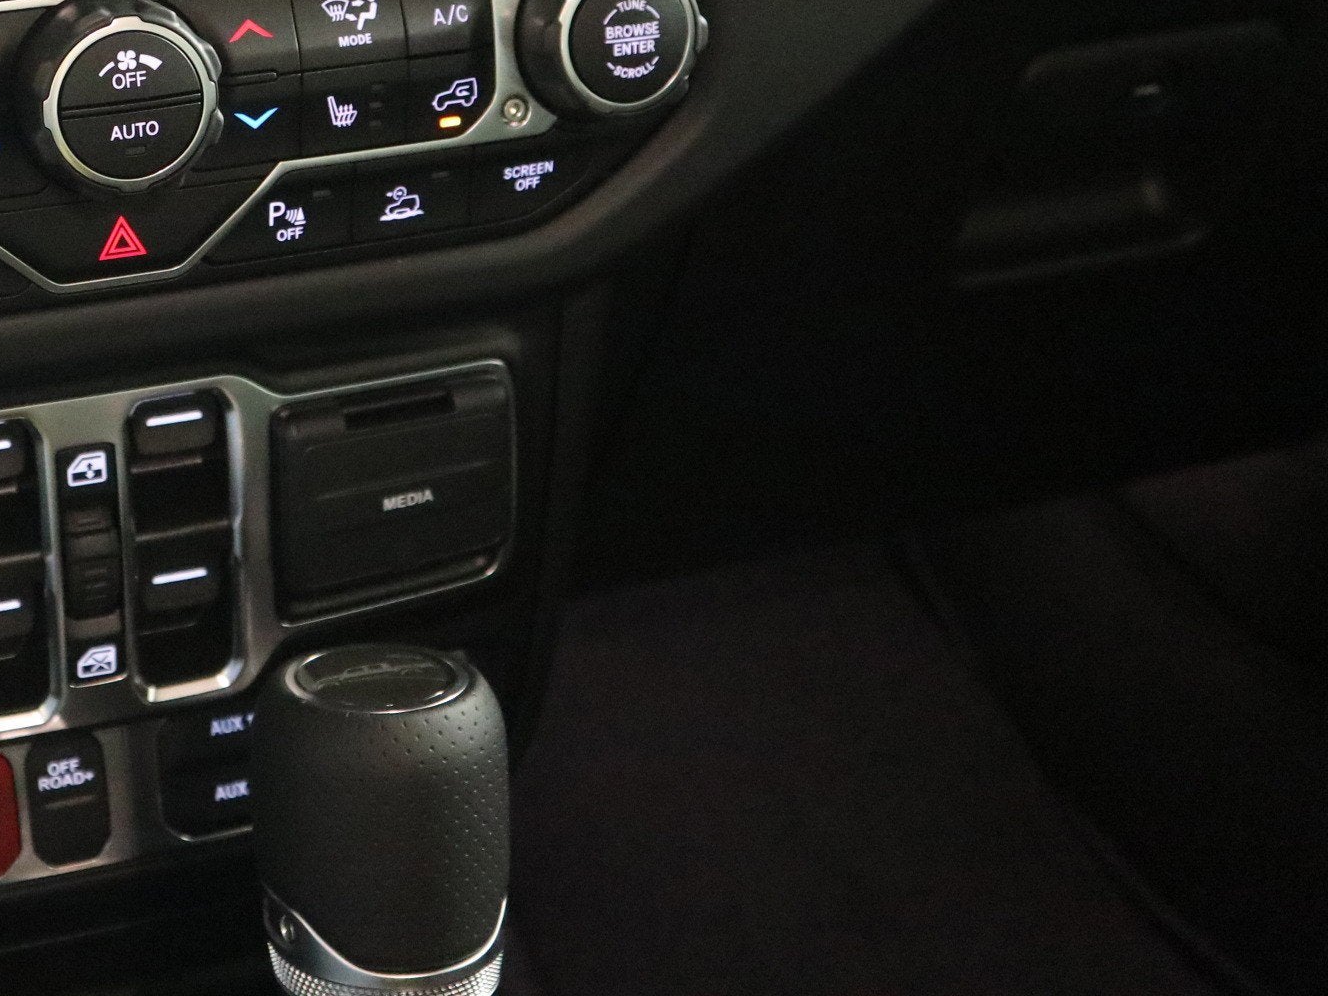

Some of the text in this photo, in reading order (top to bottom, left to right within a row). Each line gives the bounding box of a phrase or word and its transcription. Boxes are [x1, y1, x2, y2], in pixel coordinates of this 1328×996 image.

[433, 4, 469, 26] A/C
[616, 0, 647, 13] TUNE
[605, 21, 660, 38] BROWSE
[338, 33, 373, 48] MODE
[613, 40, 656, 56] ENTER
[612, 62, 655, 79] SCROLL
[112, 71, 147, 90] OFF
[110, 121, 160, 140] AUTO
[503, 161, 555, 180] SCREEN
[514, 177, 541, 191] OFF
[276, 227, 304, 242] OFF
[383, 488, 434, 512] MEDIA
[210, 715, 244, 737] AUX
[47, 757, 80, 777] OFF
[37, 770, 95, 792] ROAD+
[215, 779, 249, 802] AUX
